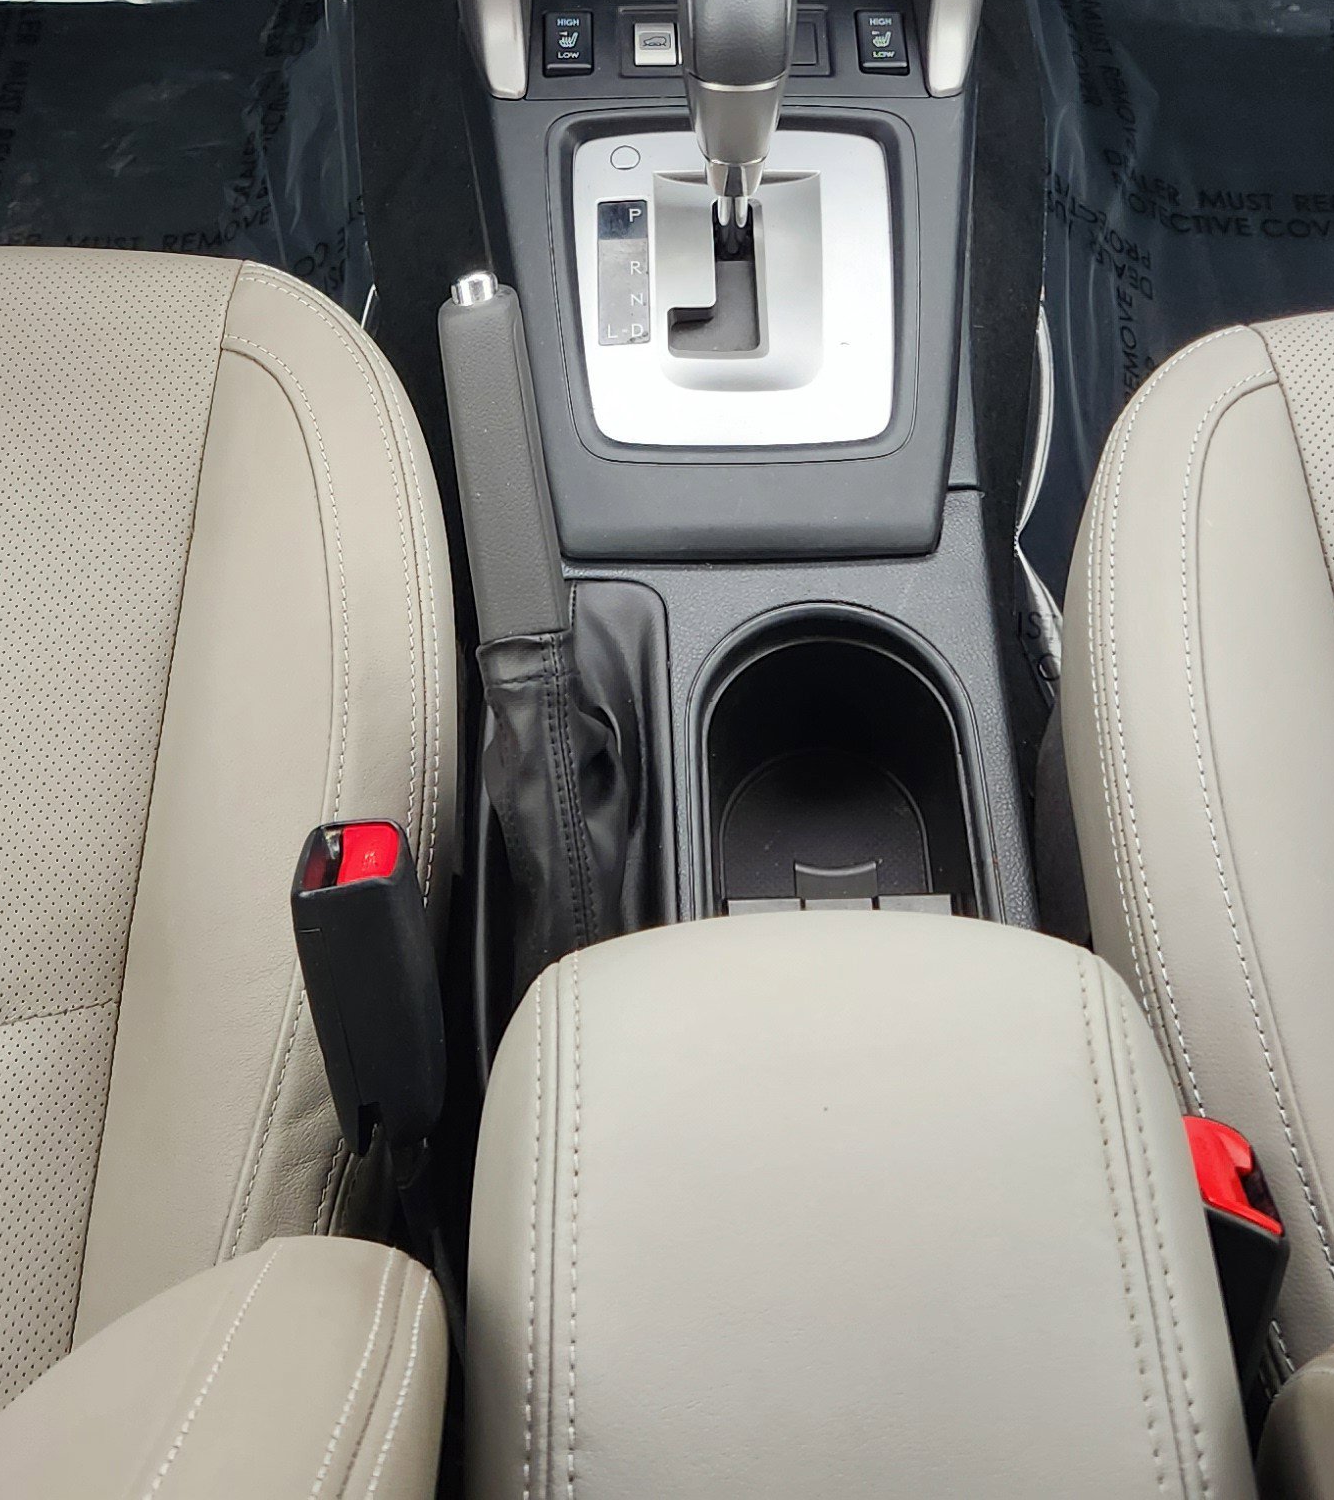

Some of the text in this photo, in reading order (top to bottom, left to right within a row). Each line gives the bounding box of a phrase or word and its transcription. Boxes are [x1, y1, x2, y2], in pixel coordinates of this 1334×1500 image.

[557, 18, 579, 26] HIGH
[870, 18, 892, 26] HIGH
[1079, 0, 1114, 56] MUST
[558, 51, 579, 59] LOW
[1198, 188, 1275, 213] MUST
[629, 208, 642, 222] P
[630, 261, 642, 275] R
[631, 293, 643, 306] N
